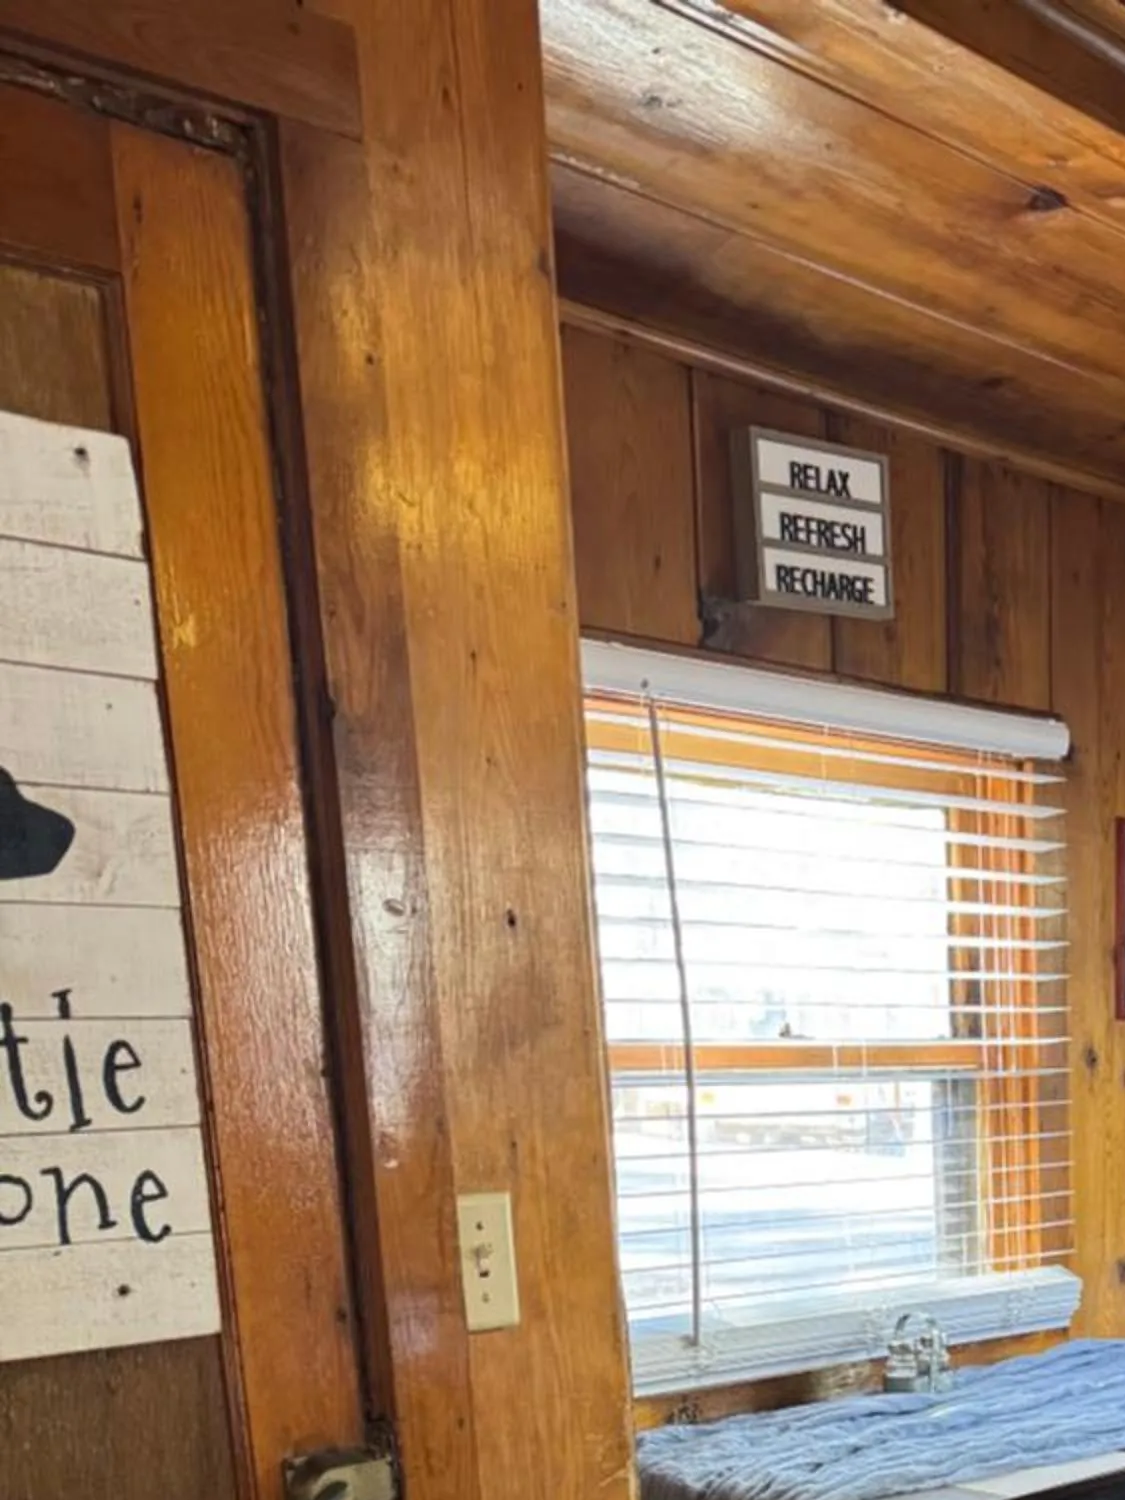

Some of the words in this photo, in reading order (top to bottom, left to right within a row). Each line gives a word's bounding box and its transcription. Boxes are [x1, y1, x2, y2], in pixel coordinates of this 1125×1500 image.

[790, 461, 850, 497] RELAX
[779, 511, 867, 555] REFRESH
[775, 564, 875, 605] RECHARGE
